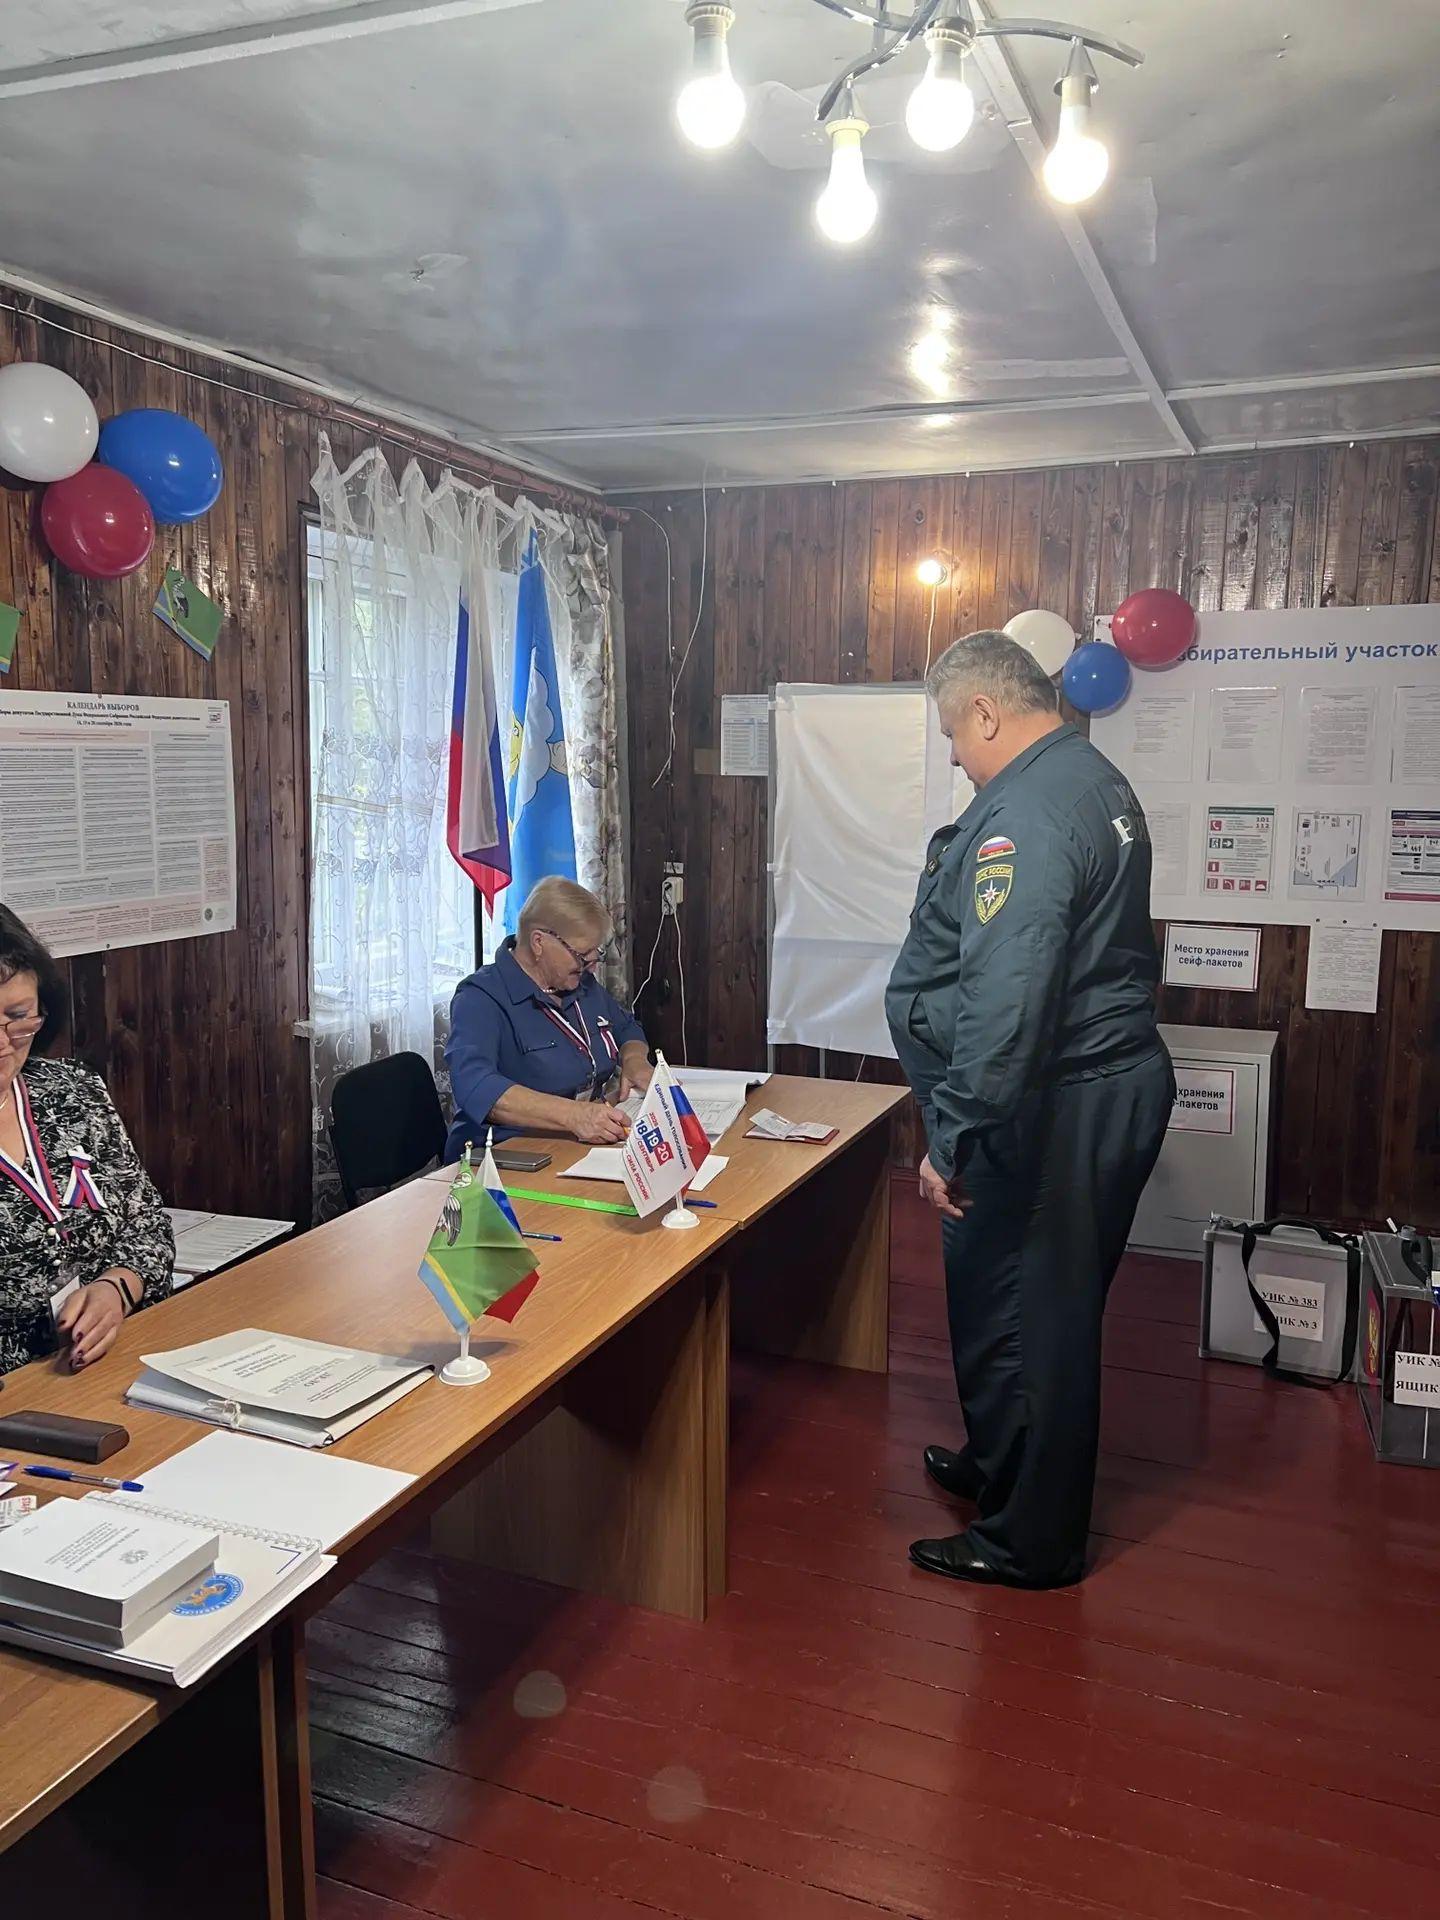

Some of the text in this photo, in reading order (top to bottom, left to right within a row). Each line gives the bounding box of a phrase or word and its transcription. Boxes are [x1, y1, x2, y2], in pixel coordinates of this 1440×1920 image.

[1175, 642, 1438, 664] збирательный участок
[67, 702, 140, 711] КАЛЕНДАРЬ ВЫБОРОВ
[1174, 943, 1249, 957] Место хранения
[1178, 955, 1243, 968] сейф-пакетов
[1178, 1088, 1225, 1099] хранения
[1172, 1100, 1219, 1111] -пакетов
[654, 1083, 688, 1170] ЕДИНЫЙ ДЕНЬ ГОЛОСОВАНИЯ
[635, 1119, 670, 1161] 18 19 20
[637, 1140, 655, 1174] СЕНТЯБРЯ
[626, 1154, 637, 1174] СИЛА
[1262, 1291, 1318, 1308] УИК № 383
[1297, 1320, 1310, 1329] №
[1311, 1321, 1318, 1330] 3
[1397, 1354, 1425, 1366] УИК
[1396, 1380, 1439, 1393] ЯЩИК
